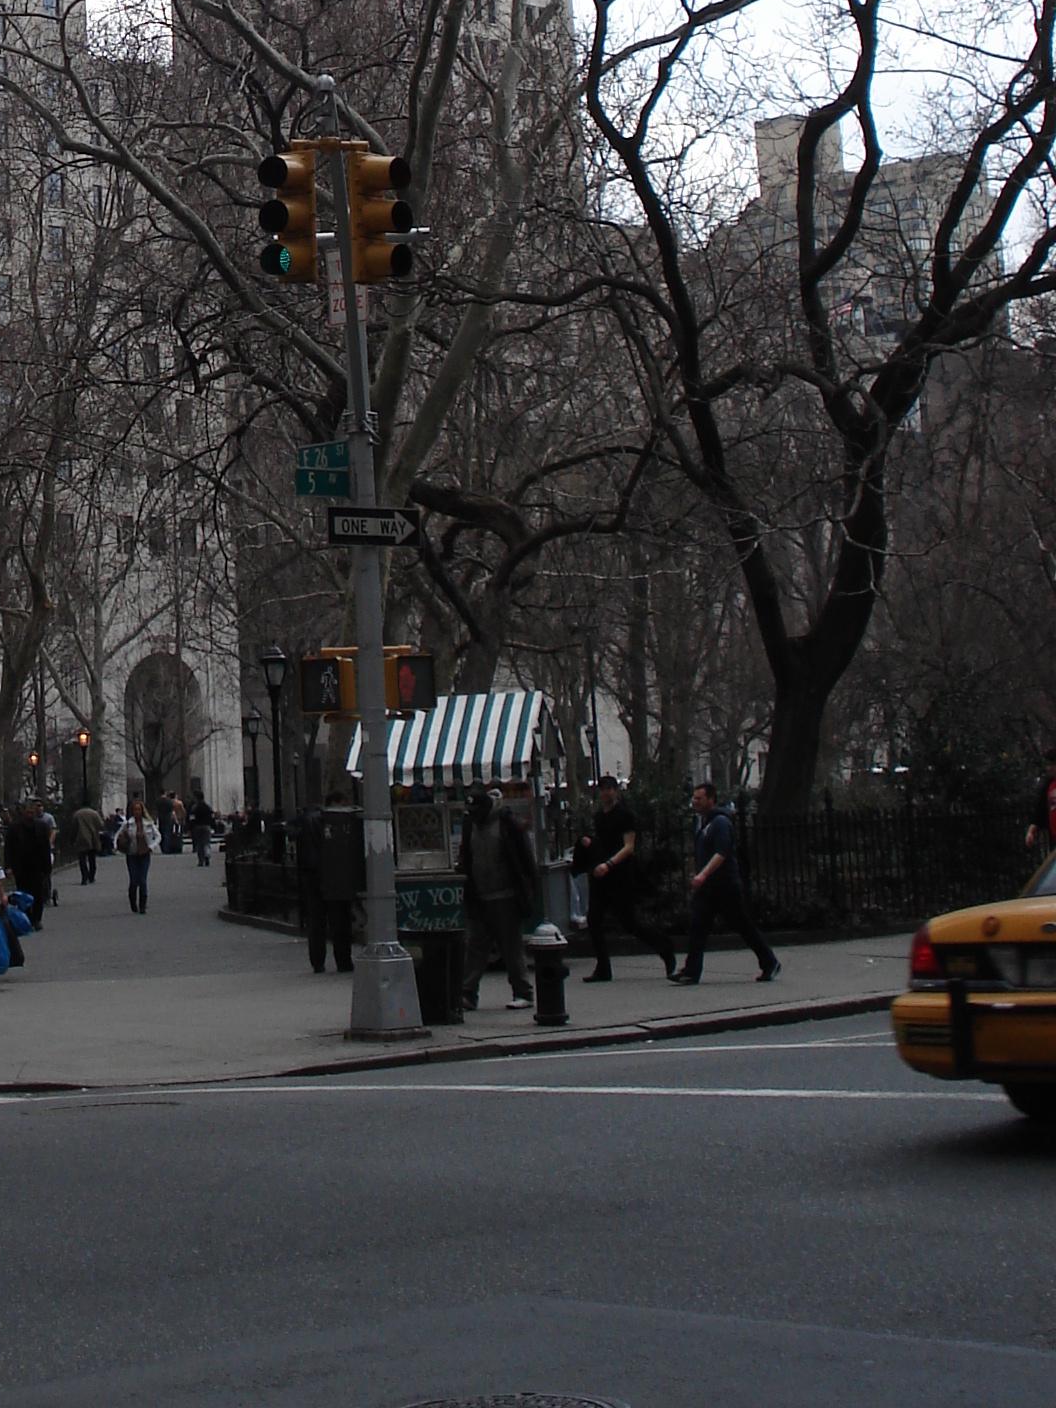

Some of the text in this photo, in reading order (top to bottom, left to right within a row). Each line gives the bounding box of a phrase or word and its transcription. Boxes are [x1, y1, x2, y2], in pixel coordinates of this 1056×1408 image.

[332, 294, 364, 313] ZOE
[314, 447, 328, 468] 26
[335, 444, 344, 456] ST
[308, 472, 316, 494] 5
[341, 518, 406, 535] ONE WAY
[395, 887, 464, 911] EW YOR
